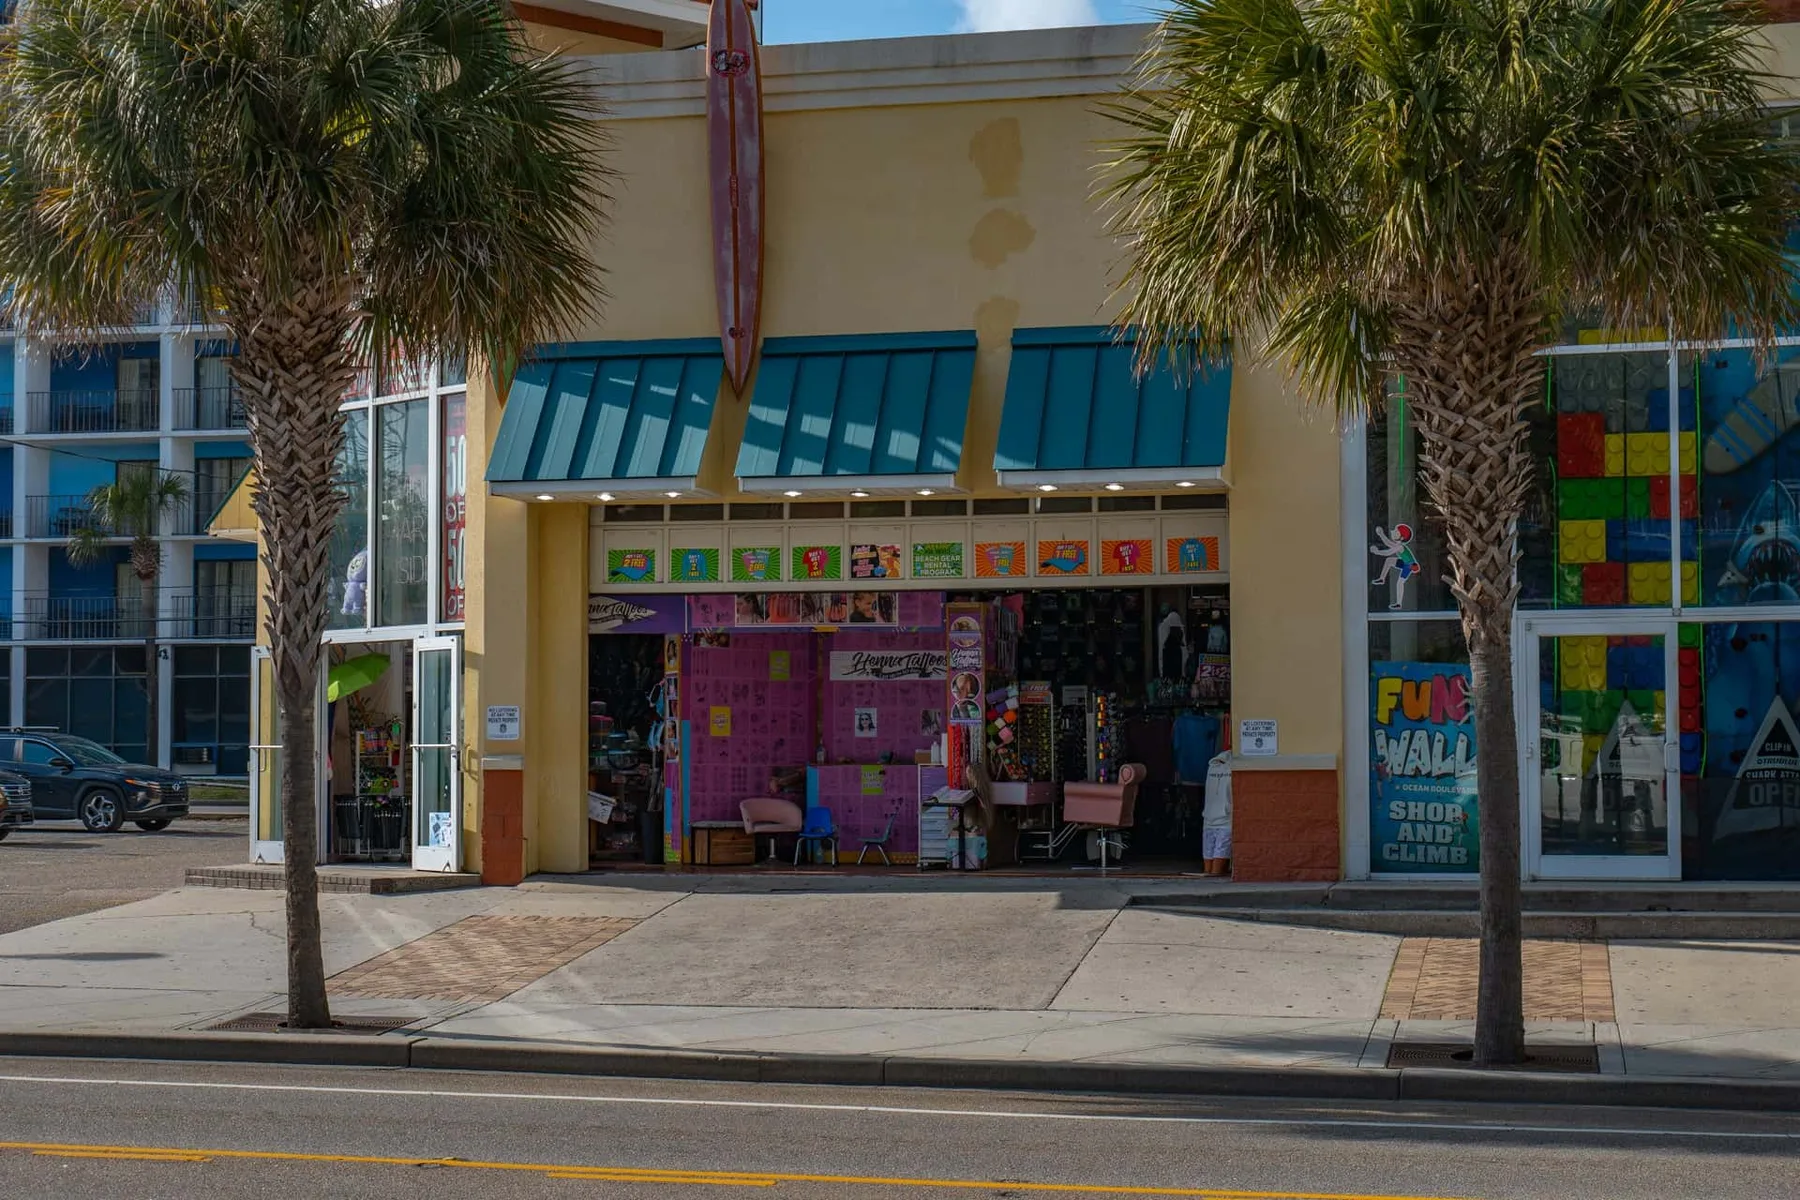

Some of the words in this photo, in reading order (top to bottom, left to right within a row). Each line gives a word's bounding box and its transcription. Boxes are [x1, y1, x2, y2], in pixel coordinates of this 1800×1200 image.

[853, 652, 903, 670] Henna
[1375, 673, 1472, 725] FUN
[1374, 729, 1478, 779] WALL
[1746, 770, 1777, 779] SHARK
[1402, 784, 1430, 793] OCEAN
[1389, 800, 1464, 824] SHOP
[1397, 822, 1454, 844] AND
[1381, 843, 1469, 865] CLIMB
